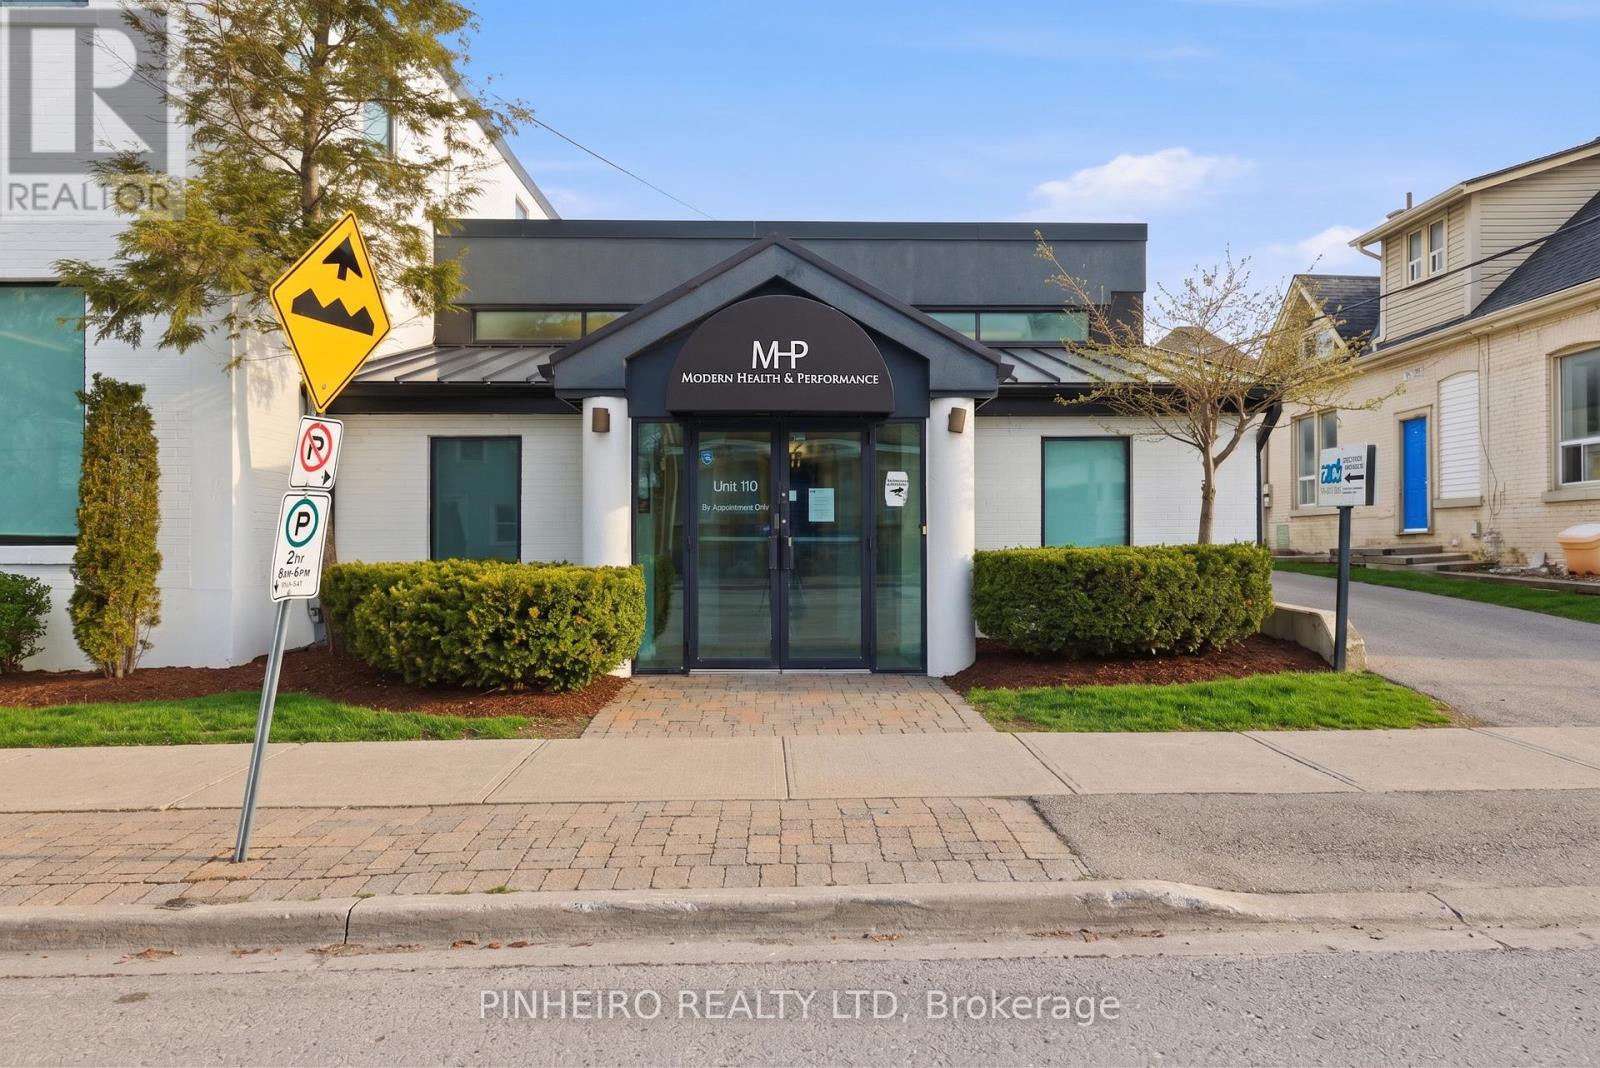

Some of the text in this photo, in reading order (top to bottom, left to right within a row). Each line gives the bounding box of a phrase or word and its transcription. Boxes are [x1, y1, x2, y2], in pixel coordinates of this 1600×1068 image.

[681, 371, 880, 385] MODERN HEALTH & PERFORMANCE
[306, 435, 325, 460] P
[713, 480, 758, 492] Unit 110
[702, 503, 770, 513] By Appointment Only
[294, 511, 311, 537] P
[286, 550, 305, 565] 2hr
